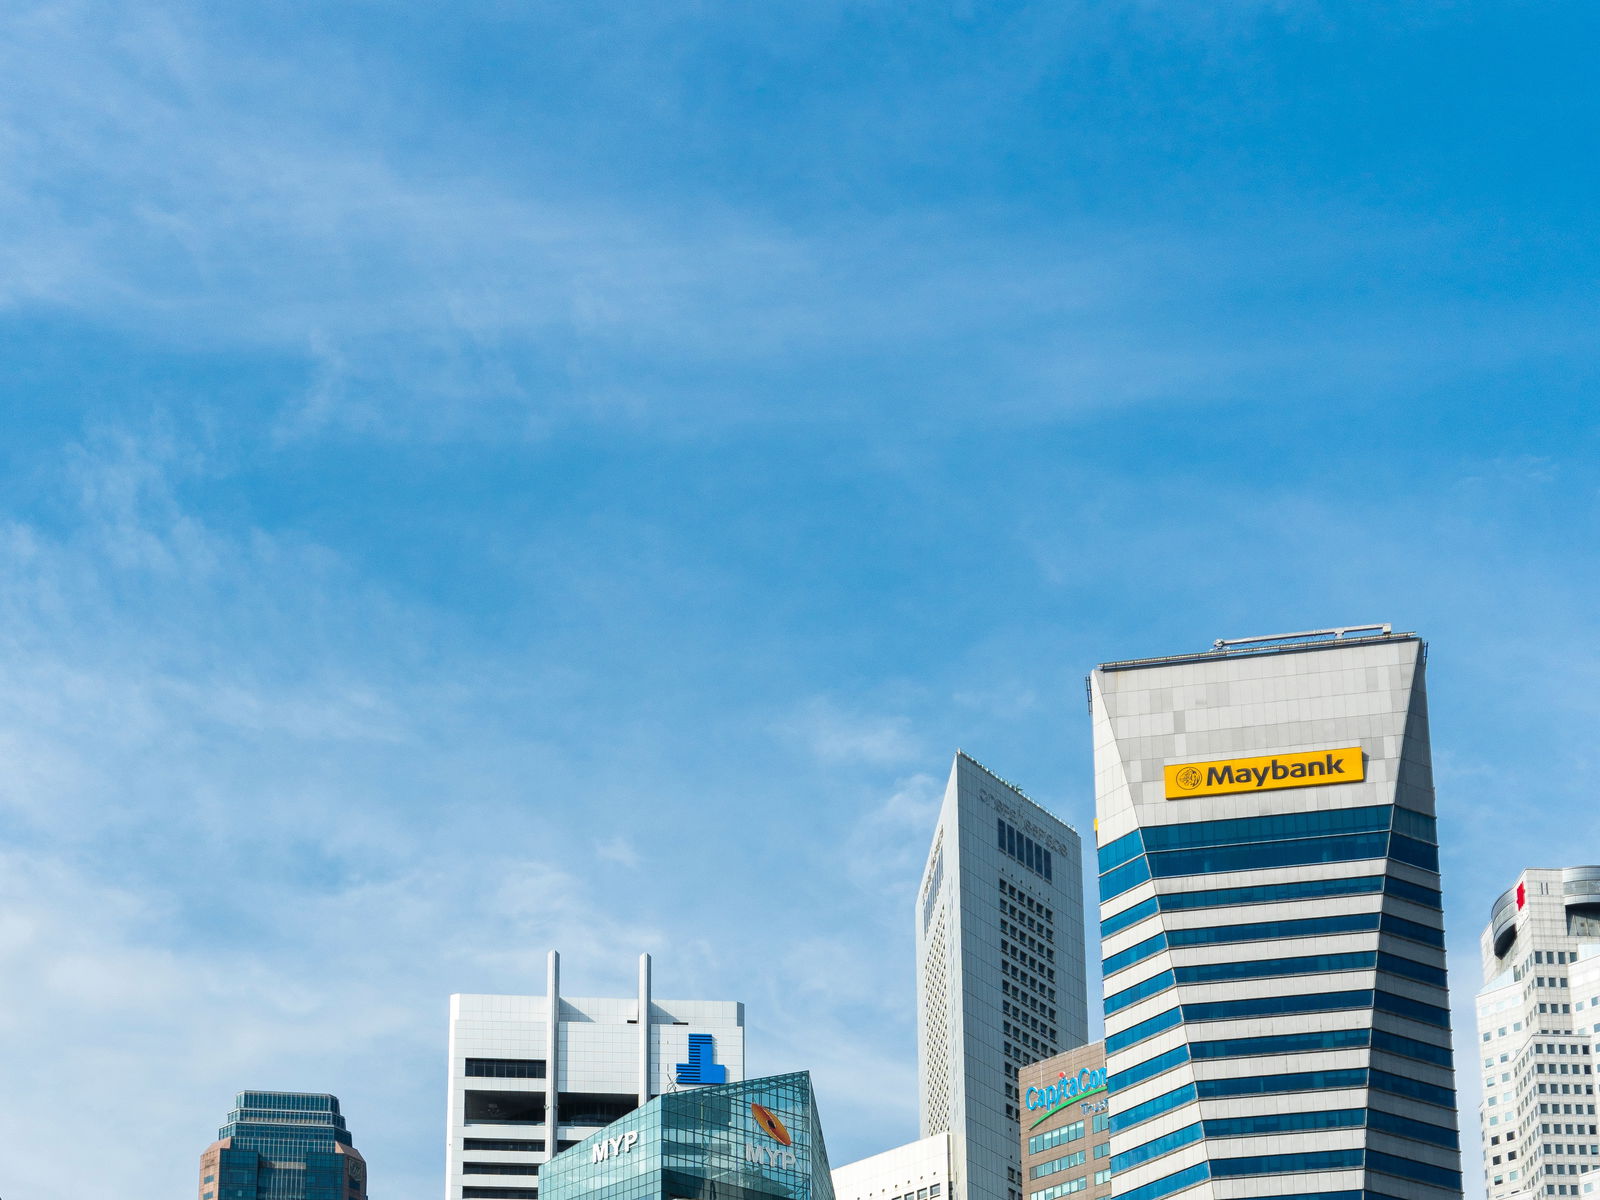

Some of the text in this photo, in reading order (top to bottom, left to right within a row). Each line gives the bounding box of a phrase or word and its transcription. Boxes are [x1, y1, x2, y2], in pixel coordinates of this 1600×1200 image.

[1206, 754, 1345, 786] Maybank
[592, 1130, 639, 1164] MYP
[745, 1143, 796, 1170] MYP
